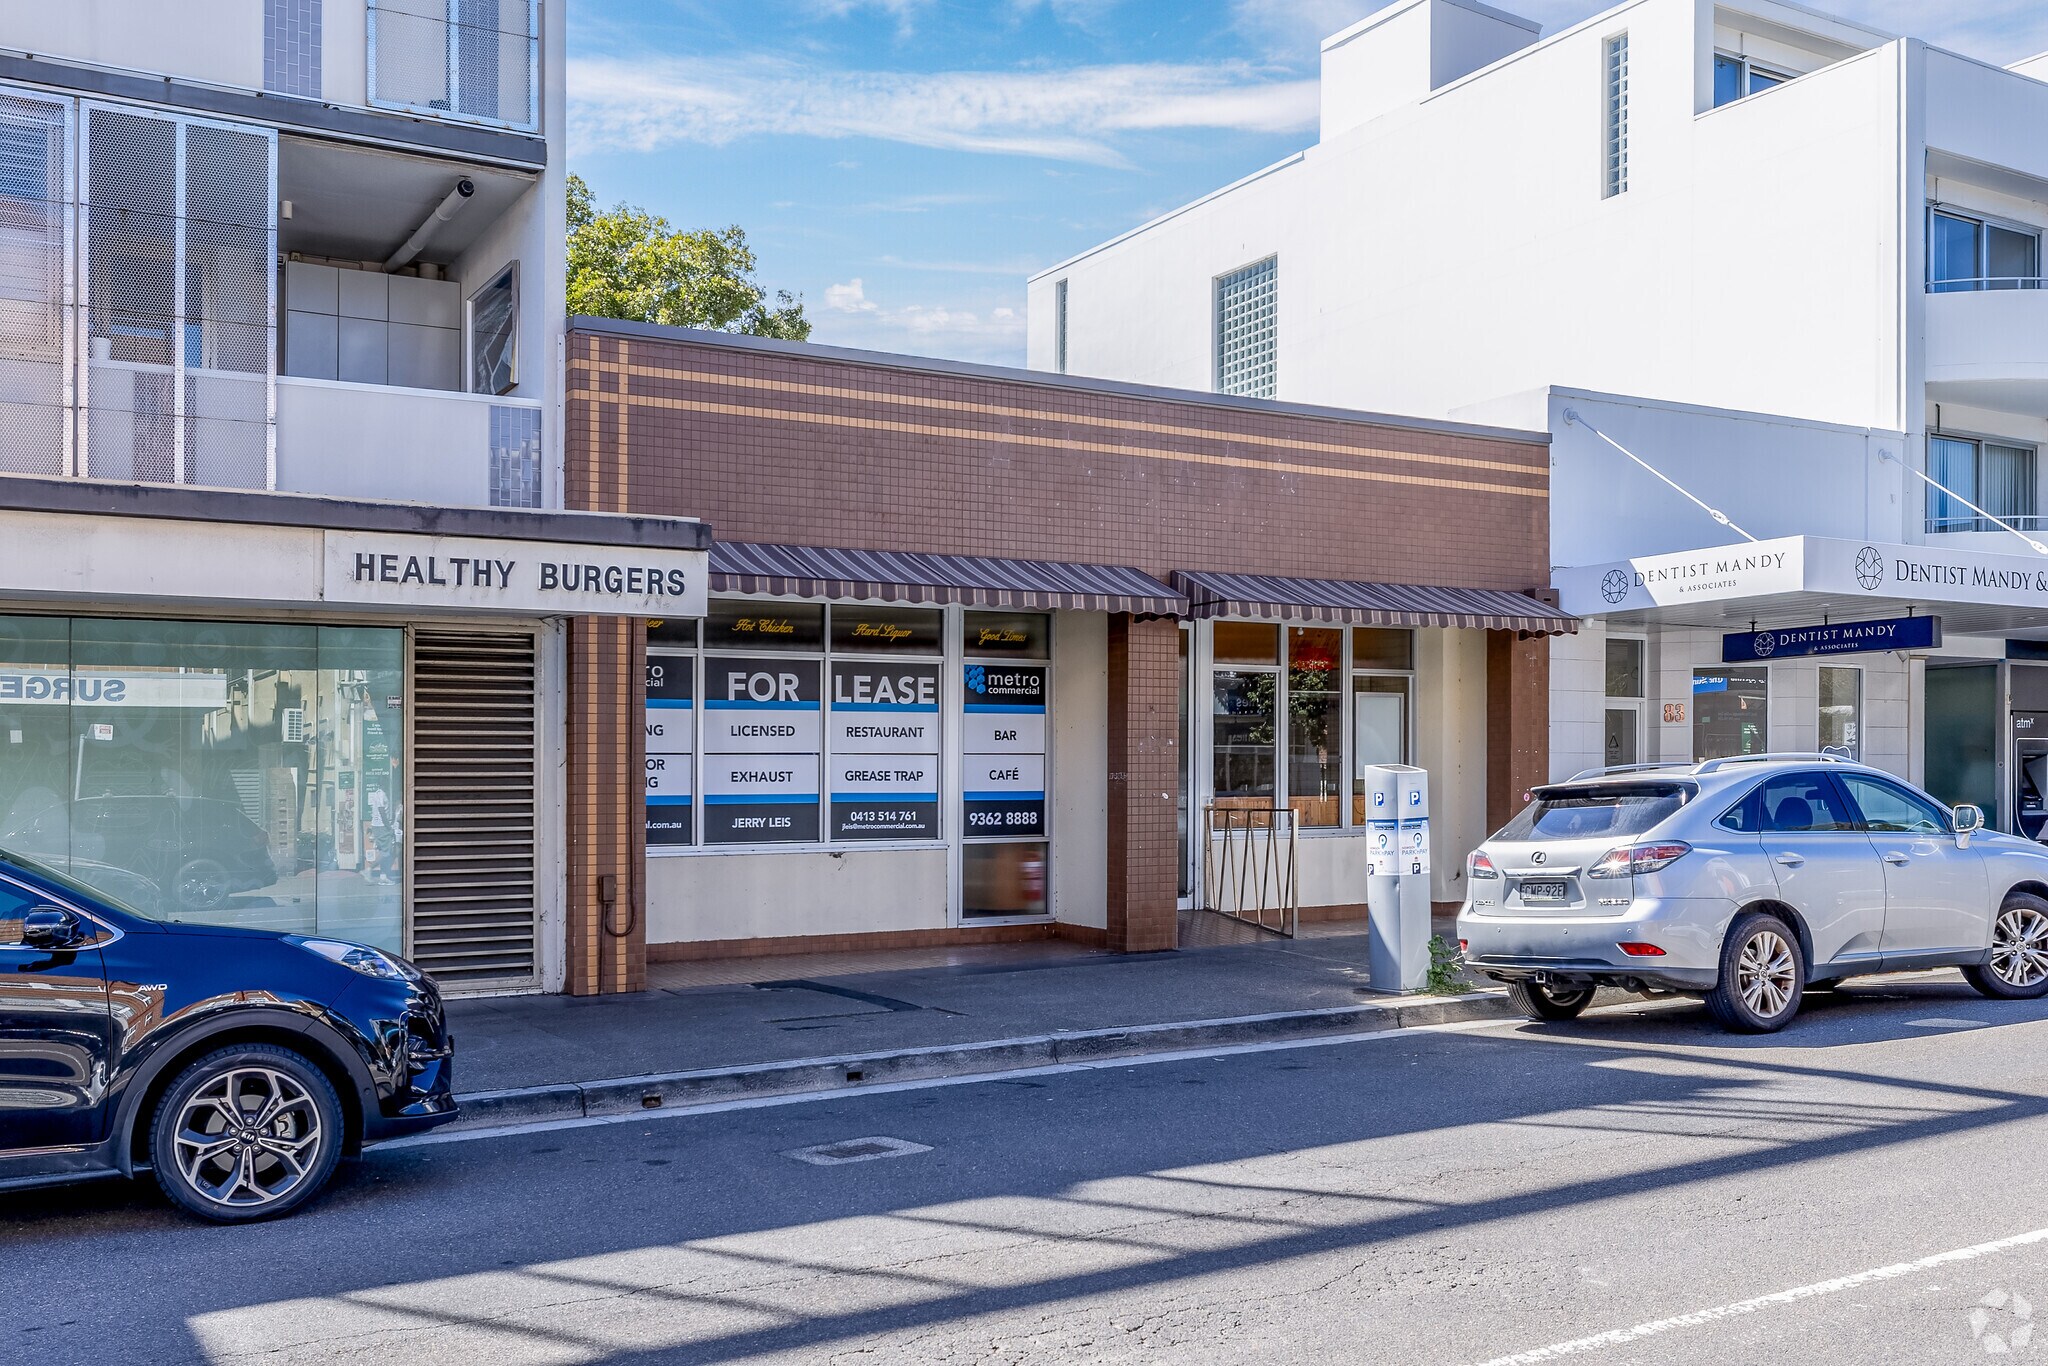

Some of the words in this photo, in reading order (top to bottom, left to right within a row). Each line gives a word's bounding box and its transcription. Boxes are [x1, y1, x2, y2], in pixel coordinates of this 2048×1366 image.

[353, 552, 516, 588] HEALTHY
[538, 562, 686, 597] BURGERS
[1634, 562, 1709, 587] DENTIST
[1715, 552, 1786, 574] MANDY
[1895, 559, 1967, 585] DENTIST
[1972, 566, 2032, 590] MANDY
[2035, 570, 2048, 592] &
[1687, 579, 1738, 592] ASSOCIATES
[731, 618, 756, 631] Hot
[759, 618, 794, 634] Chicken
[851, 623, 882, 636] Hard
[880, 624, 913, 642] Liquor
[978, 628, 1001, 646] Good
[1000, 629, 1027, 642] Times
[1780, 629, 1838, 646] DENTIST
[1843, 624, 1896, 639] MANDY
[1820, 642, 1859, 650] ASSOCIATES
[988, 672, 1040, 686] metro
[728, 672, 800, 702] FOR
[835, 674, 936, 705] LEASE
[988, 686, 1040, 695] commercial
[1664, 703, 1685, 722] 83
[730, 725, 796, 737] LICENSED
[846, 726, 925, 738] RESTAURANT
[994, 730, 1017, 741] BAR
[730, 771, 793, 783] EXHAUST
[844, 770, 891, 782] GREASE
[894, 770, 924, 782] TRAP
[989, 767, 1019, 781] CAFÉ
[850, 811, 875, 821] 0413
[878, 811, 897, 821] 514
[899, 811, 917, 821] 761
[969, 811, 1002, 826] 9362
[1005, 811, 1038, 825] 8888
[731, 817, 765, 829] JERRY
[768, 817, 791, 828] LEIS
[138, 983, 168, 991] AWD
[241, 1131, 255, 1141] KIA
